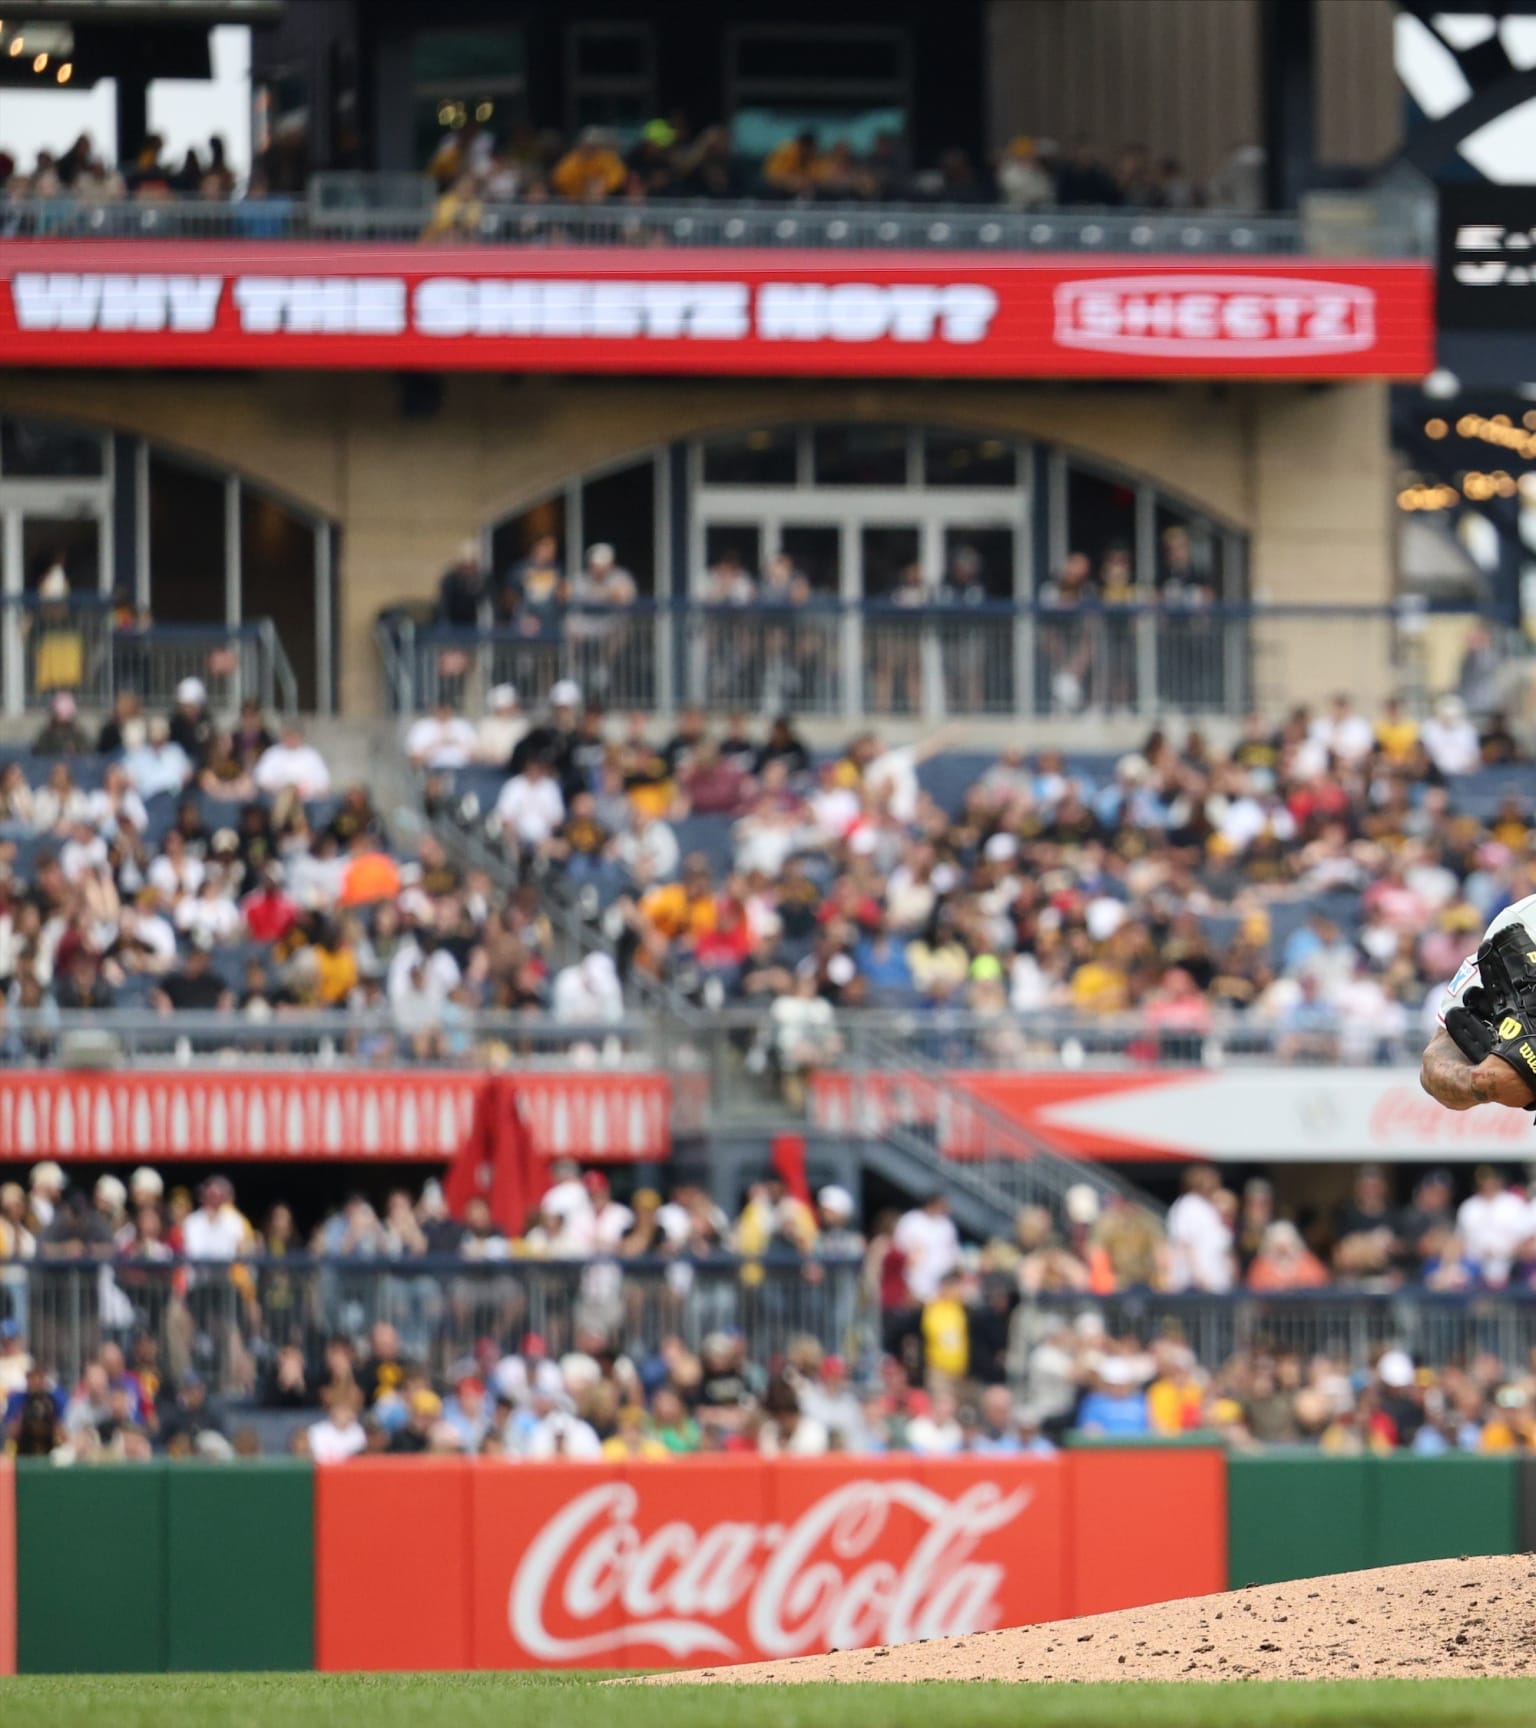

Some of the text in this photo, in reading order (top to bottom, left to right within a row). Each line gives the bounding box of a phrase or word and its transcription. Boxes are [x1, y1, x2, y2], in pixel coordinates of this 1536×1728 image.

[12, 272, 998, 343] WHY THE SHEETZ NOT?
[1074, 293, 1353, 339] SHEETZ
[508, 1480, 1034, 1659] Coca-Cola
